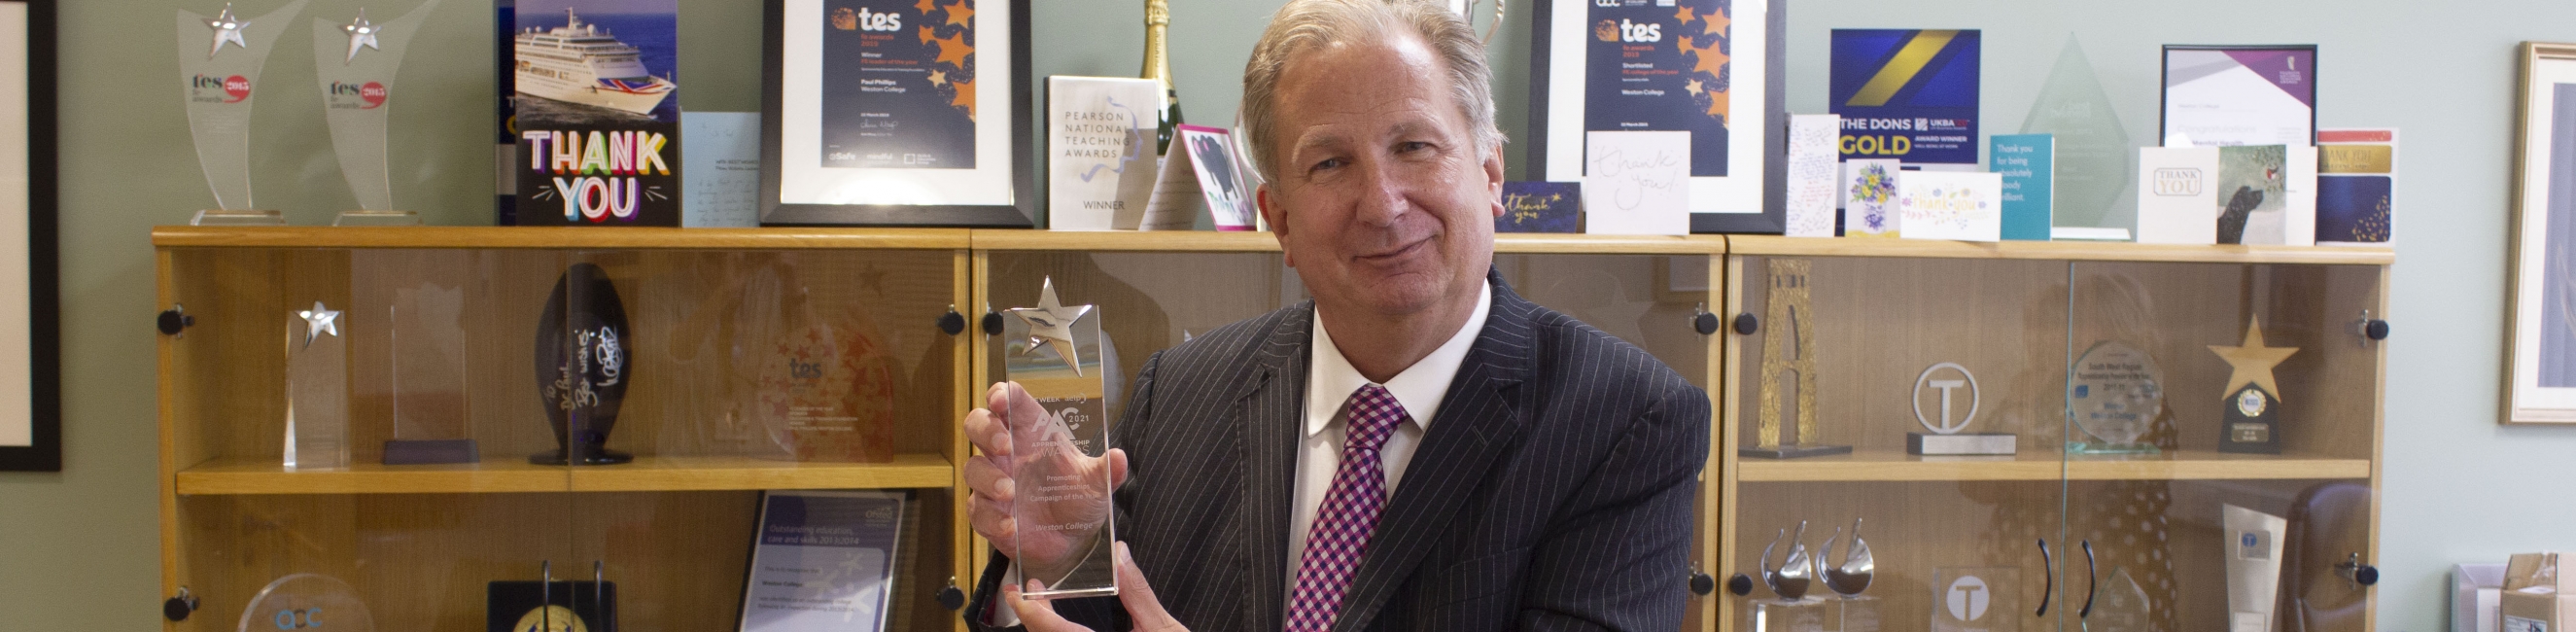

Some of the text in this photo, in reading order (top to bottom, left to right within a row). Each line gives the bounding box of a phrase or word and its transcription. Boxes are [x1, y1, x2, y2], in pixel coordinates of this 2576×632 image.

[858, 8, 901, 31] tes
[1620, 18, 1661, 42] tes
[192, 74, 223, 88] tes
[331, 80, 360, 94] tes
[1065, 111, 1124, 121] PEARSON
[1065, 124, 1130, 133] NATIONAL
[1840, 118, 1911, 130] THE DONS
[1065, 137, 1130, 146] TEACHING
[1838, 135, 1911, 155] GOLD
[522, 130, 671, 176] THANK
[1997, 144, 2018, 153] Thank
[2008, 157, 2028, 166] being
[2001, 168, 2033, 178] bsolutely
[2002, 181, 2020, 190] loody
[2159, 180, 2199, 193] YOU
[553, 177, 641, 223] YOU
[2002, 193, 2025, 201] rilliant.
[1083, 201, 1125, 210] WINNER
[1504, 193, 1550, 212] thank
[1913, 193, 1976, 218] thank you
[1514, 210, 1539, 224] you
[788, 358, 821, 378] tes
[1069, 414, 1089, 423] 2021
[1032, 444, 1090, 457] AWADS
[1037, 484, 1090, 493] Apprenticeships
[1030, 494, 1062, 503] Campaign
[865, 509, 892, 519] Ofsted
[770, 525, 814, 535] Outstanding
[1064, 522, 1093, 531] College
